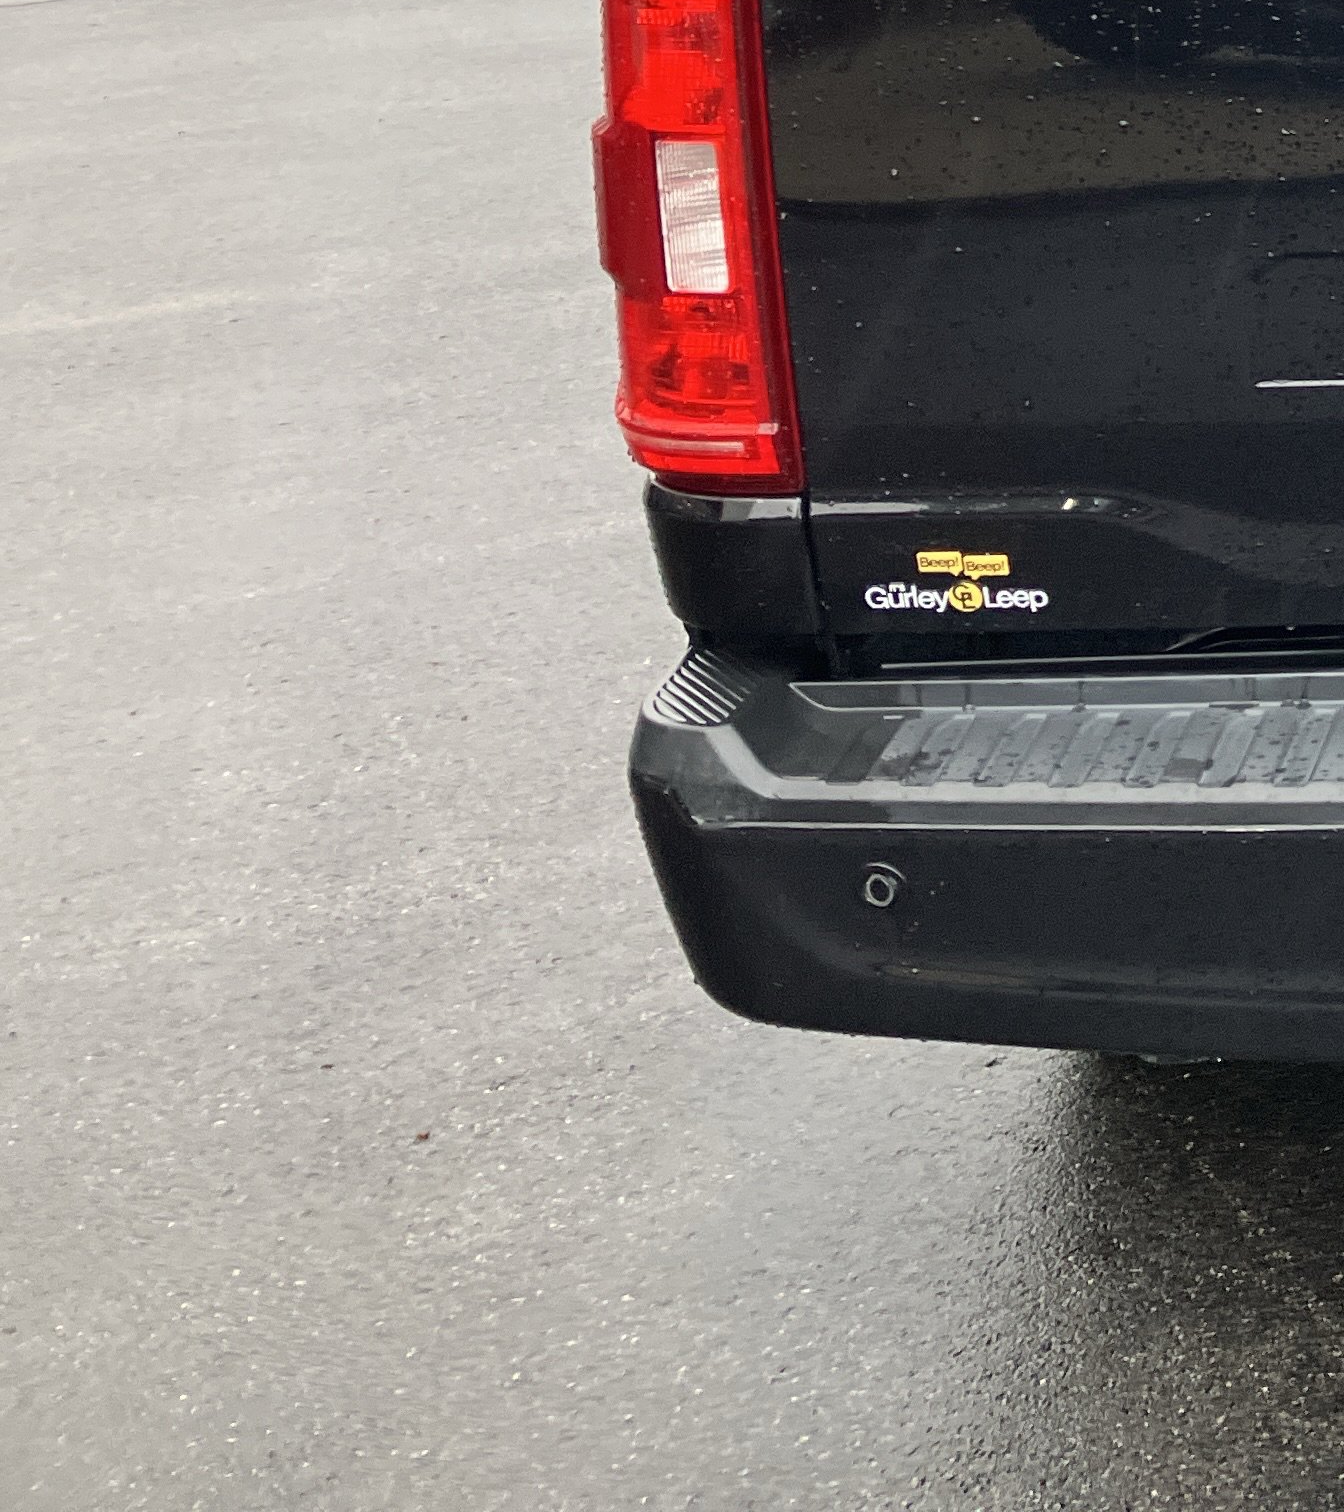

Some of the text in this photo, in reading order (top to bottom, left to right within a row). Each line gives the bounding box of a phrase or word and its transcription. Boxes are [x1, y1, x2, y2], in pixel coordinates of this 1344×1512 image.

[920, 556, 959, 569] Beep!
[965, 560, 1006, 573] Beep!
[982, 585, 1050, 614] Leep
